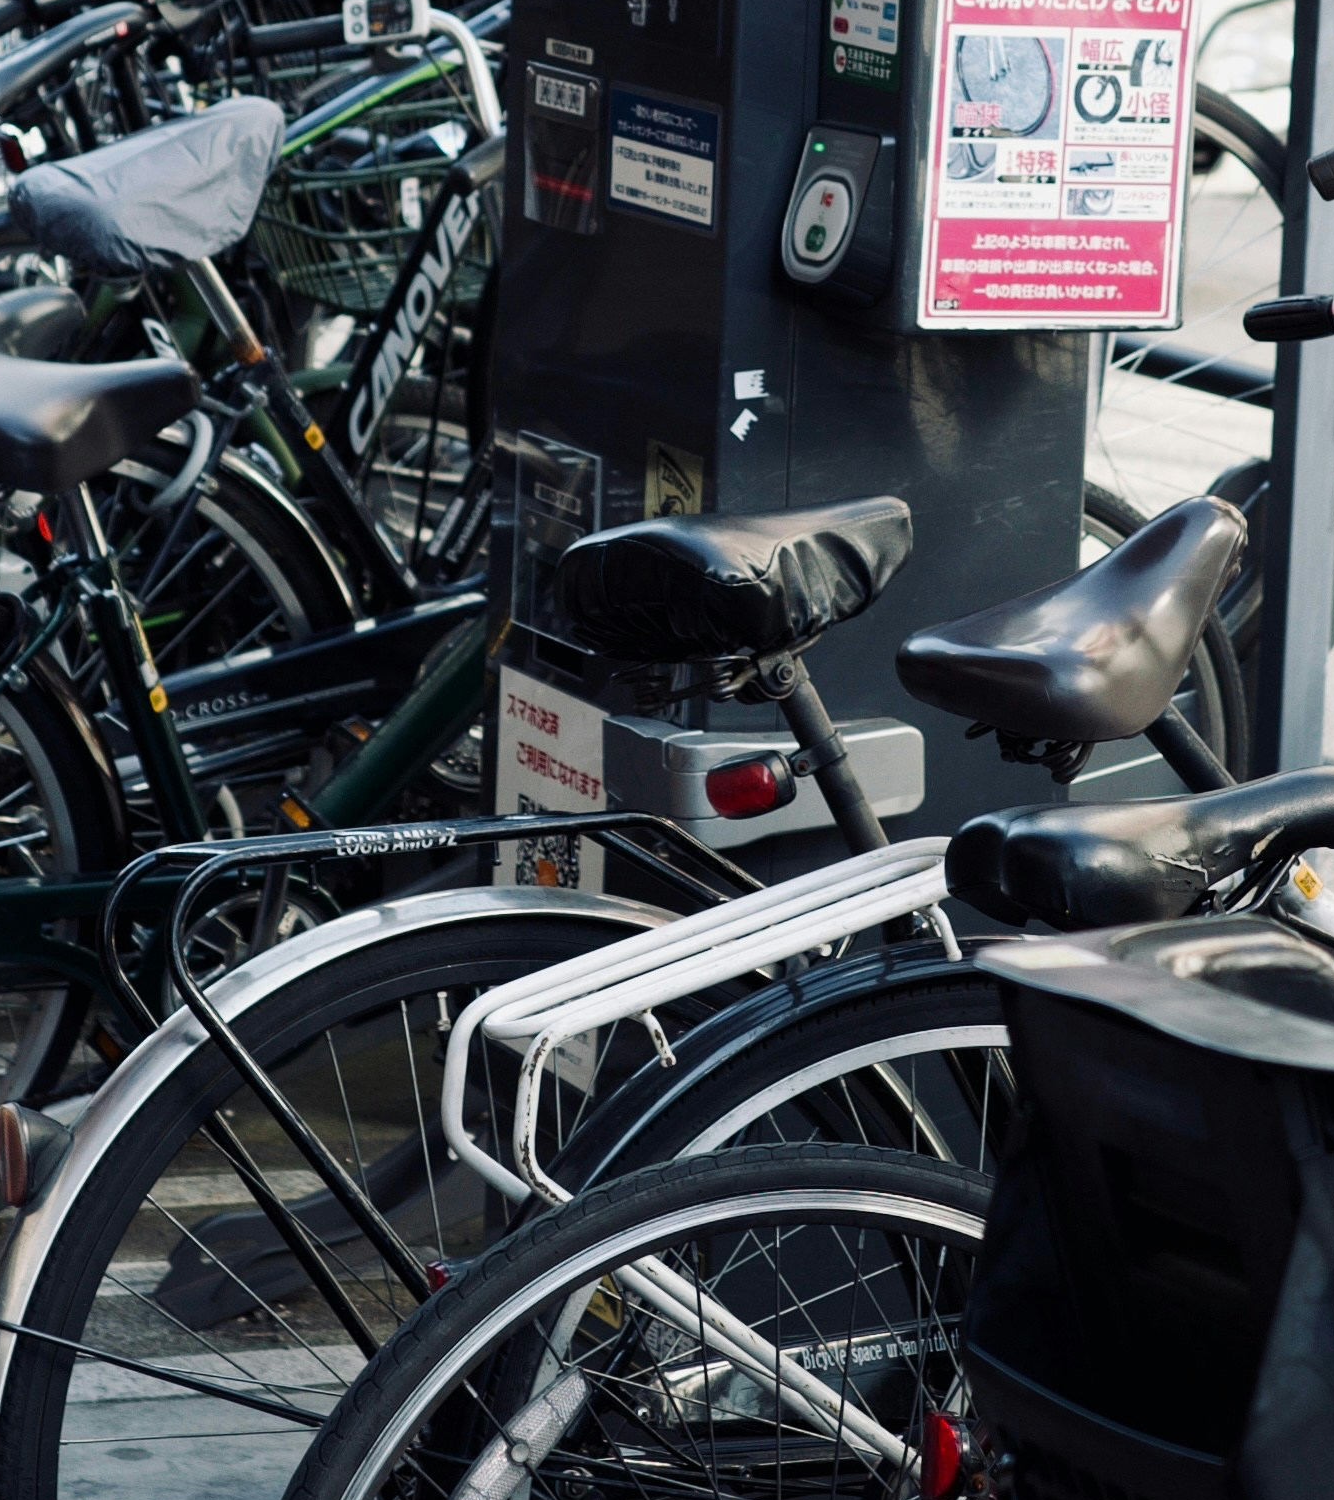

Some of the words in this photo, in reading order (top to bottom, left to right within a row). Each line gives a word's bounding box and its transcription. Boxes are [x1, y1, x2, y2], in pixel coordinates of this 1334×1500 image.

[1079, 37, 1124, 63] 幅広
[953, 102, 1001, 127] 幅狭
[1127, 91, 1170, 116] 小径
[1015, 150, 1058, 175] 特殊
[505, 692, 560, 740] スマホ決済
[515, 741, 602, 801] ご利用になれます
[801, 1343, 847, 1372] Bicycle
[850, 1346, 883, 1370] space
